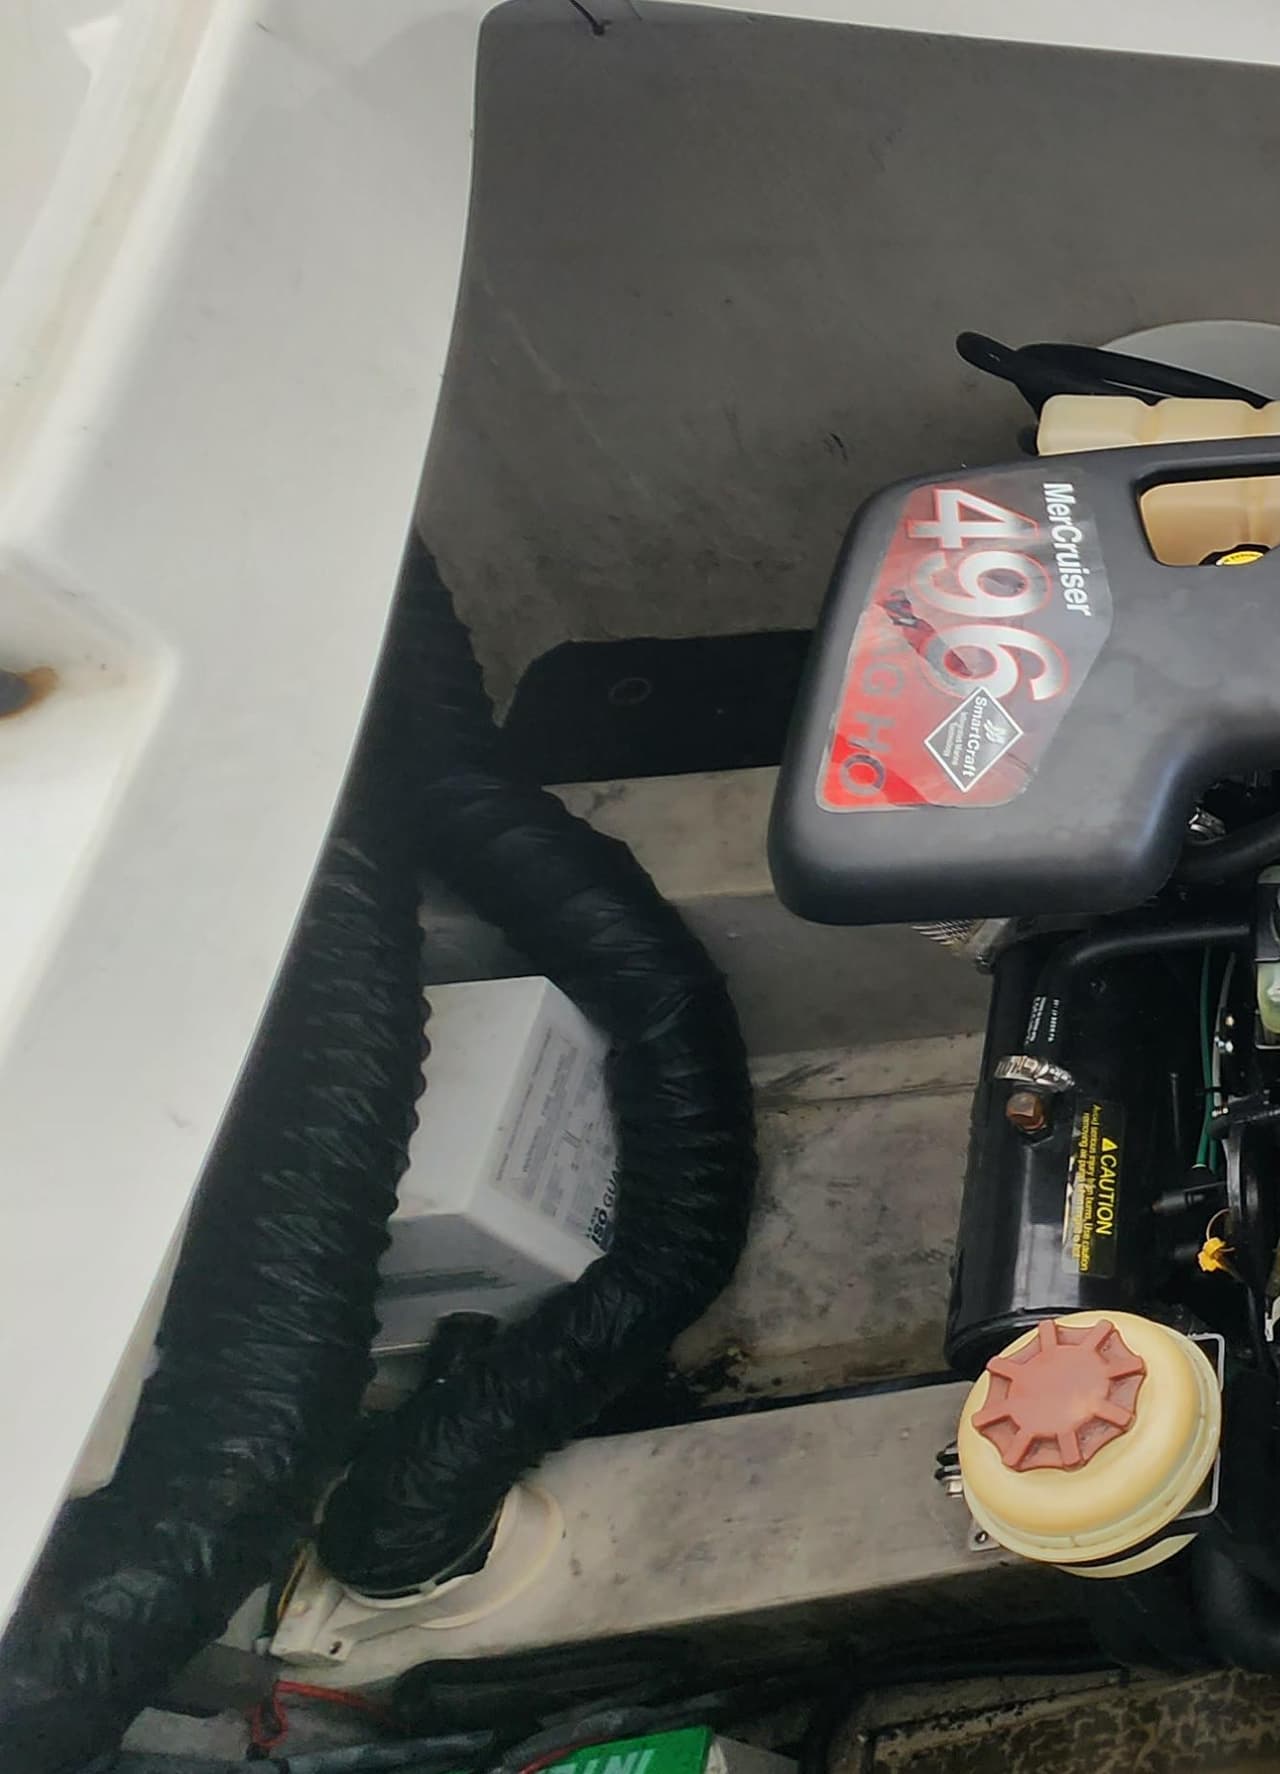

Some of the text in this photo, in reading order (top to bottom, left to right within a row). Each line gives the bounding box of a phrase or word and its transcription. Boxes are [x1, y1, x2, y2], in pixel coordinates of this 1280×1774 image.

[1043, 483, 1091, 616] MerCruiser
[904, 488, 1069, 700] 496
[963, 696, 987, 777] SmartCraft
[1096, 1154, 1117, 1236] CAUTION
[1080, 1241, 1091, 1271] caution
